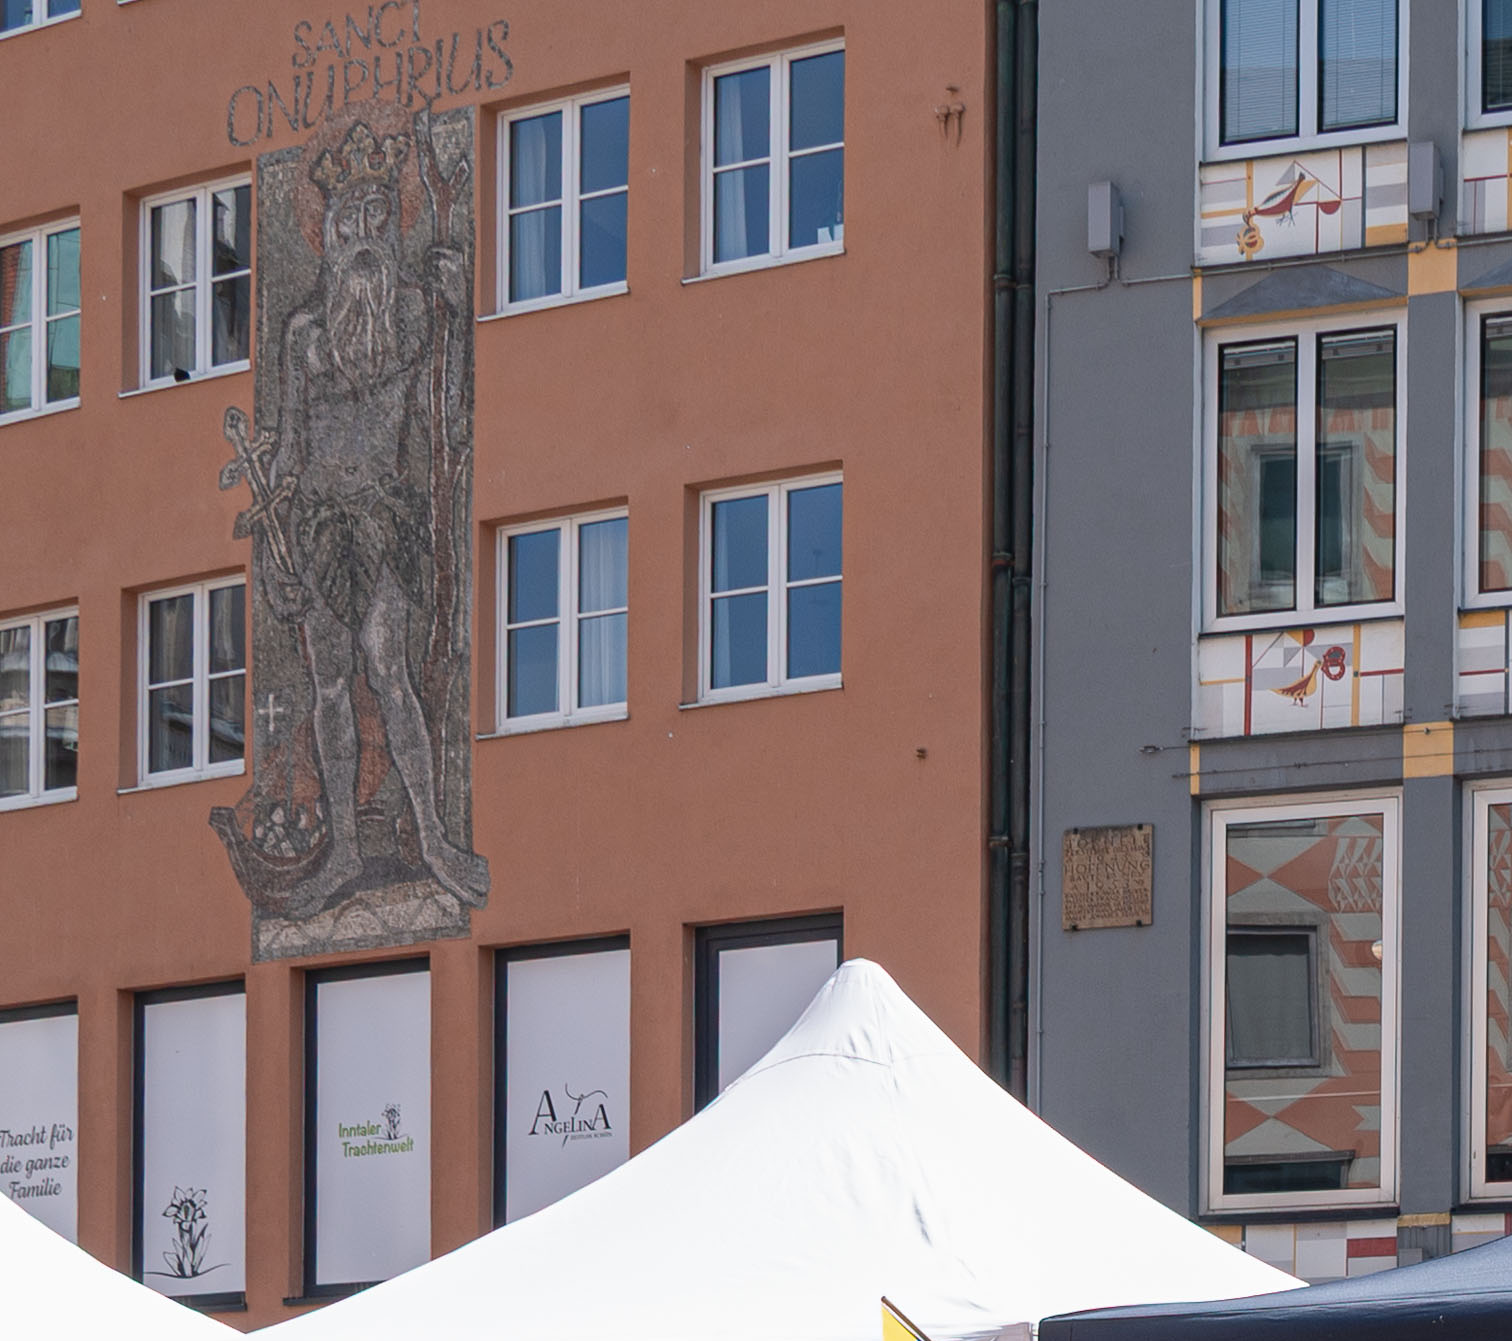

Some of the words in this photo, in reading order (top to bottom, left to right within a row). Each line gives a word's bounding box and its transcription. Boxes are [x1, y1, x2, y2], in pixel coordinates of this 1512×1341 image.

[292, 0, 420, 68] SANCT
[227, 19, 513, 146] ONUPHRIUS
[50, 1124, 74, 1150] für
[338, 1122, 381, 1139] Inntaler
[342, 1139, 414, 1158] Trachtenwelt
[0, 1155, 21, 1175] die
[25, 1154, 69, 1179] ganze
[8, 1179, 62, 1200] Familie
